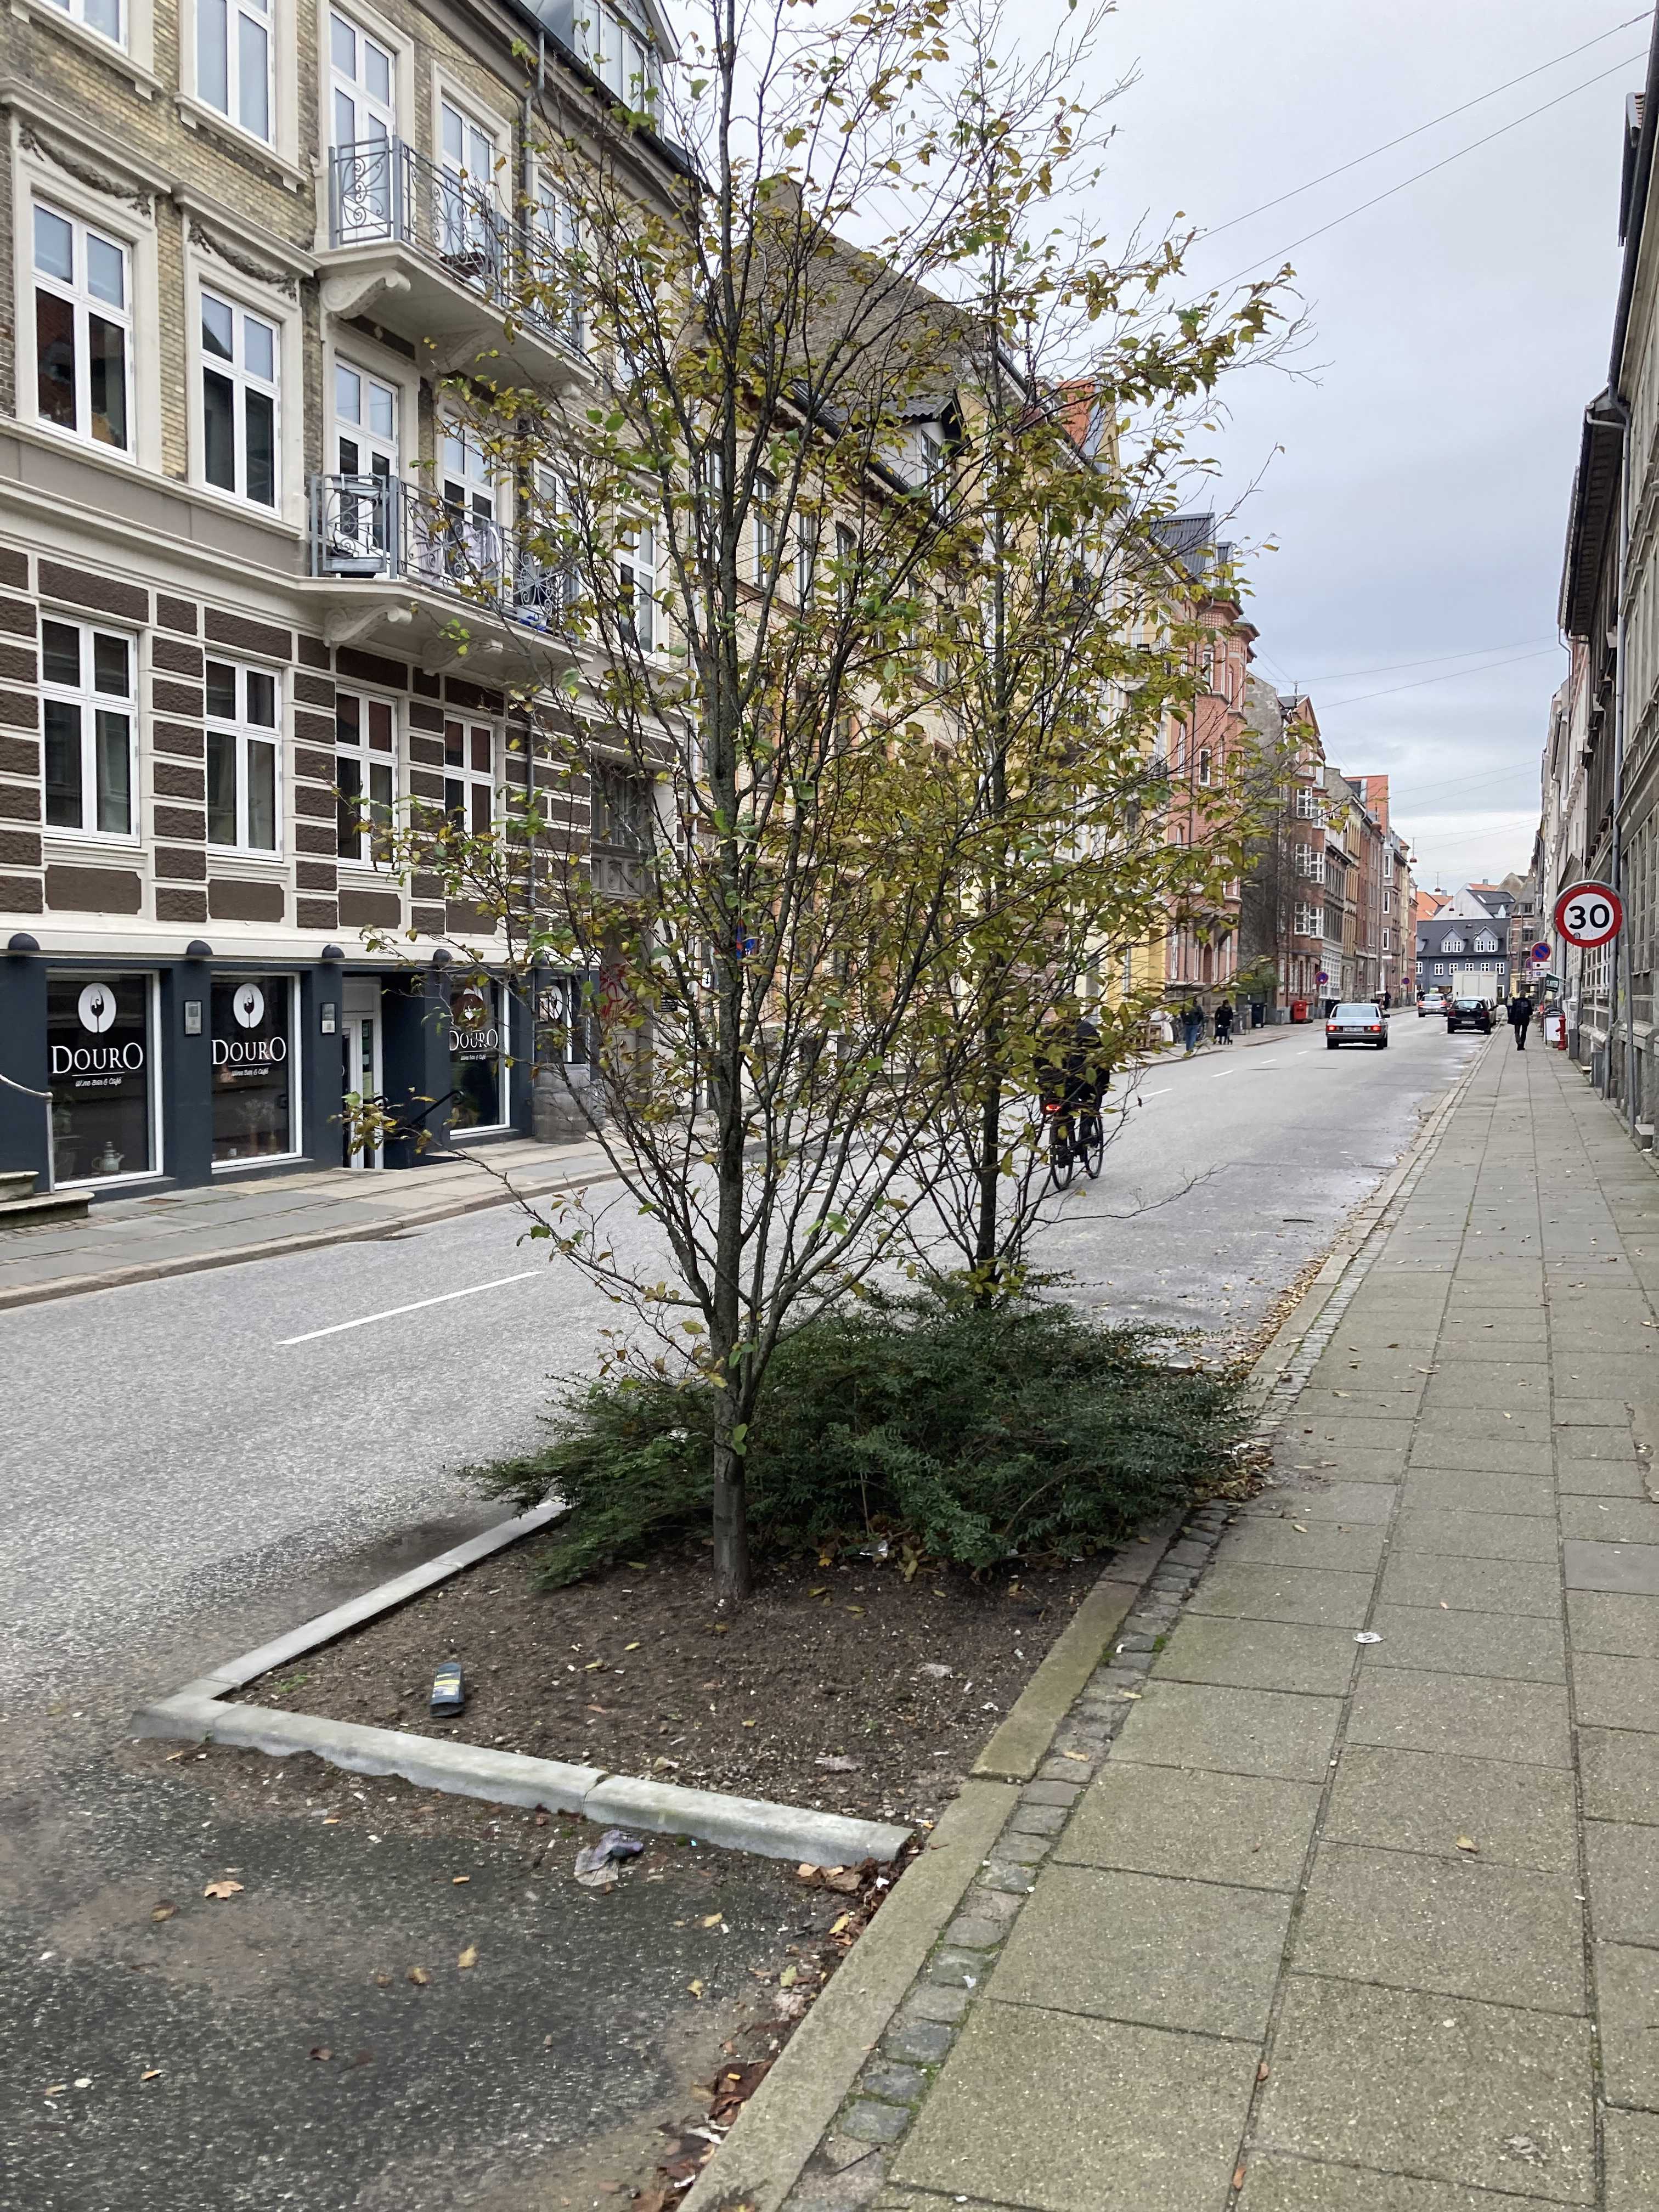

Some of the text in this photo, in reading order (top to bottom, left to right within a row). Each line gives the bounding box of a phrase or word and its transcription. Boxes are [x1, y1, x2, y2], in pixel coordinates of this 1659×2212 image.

[1568, 904, 1610, 929] 30
[211, 1037, 286, 1065] DOURO
[449, 1029, 498, 1051] DOURO
[50, 1042, 143, 1074] DOURO
